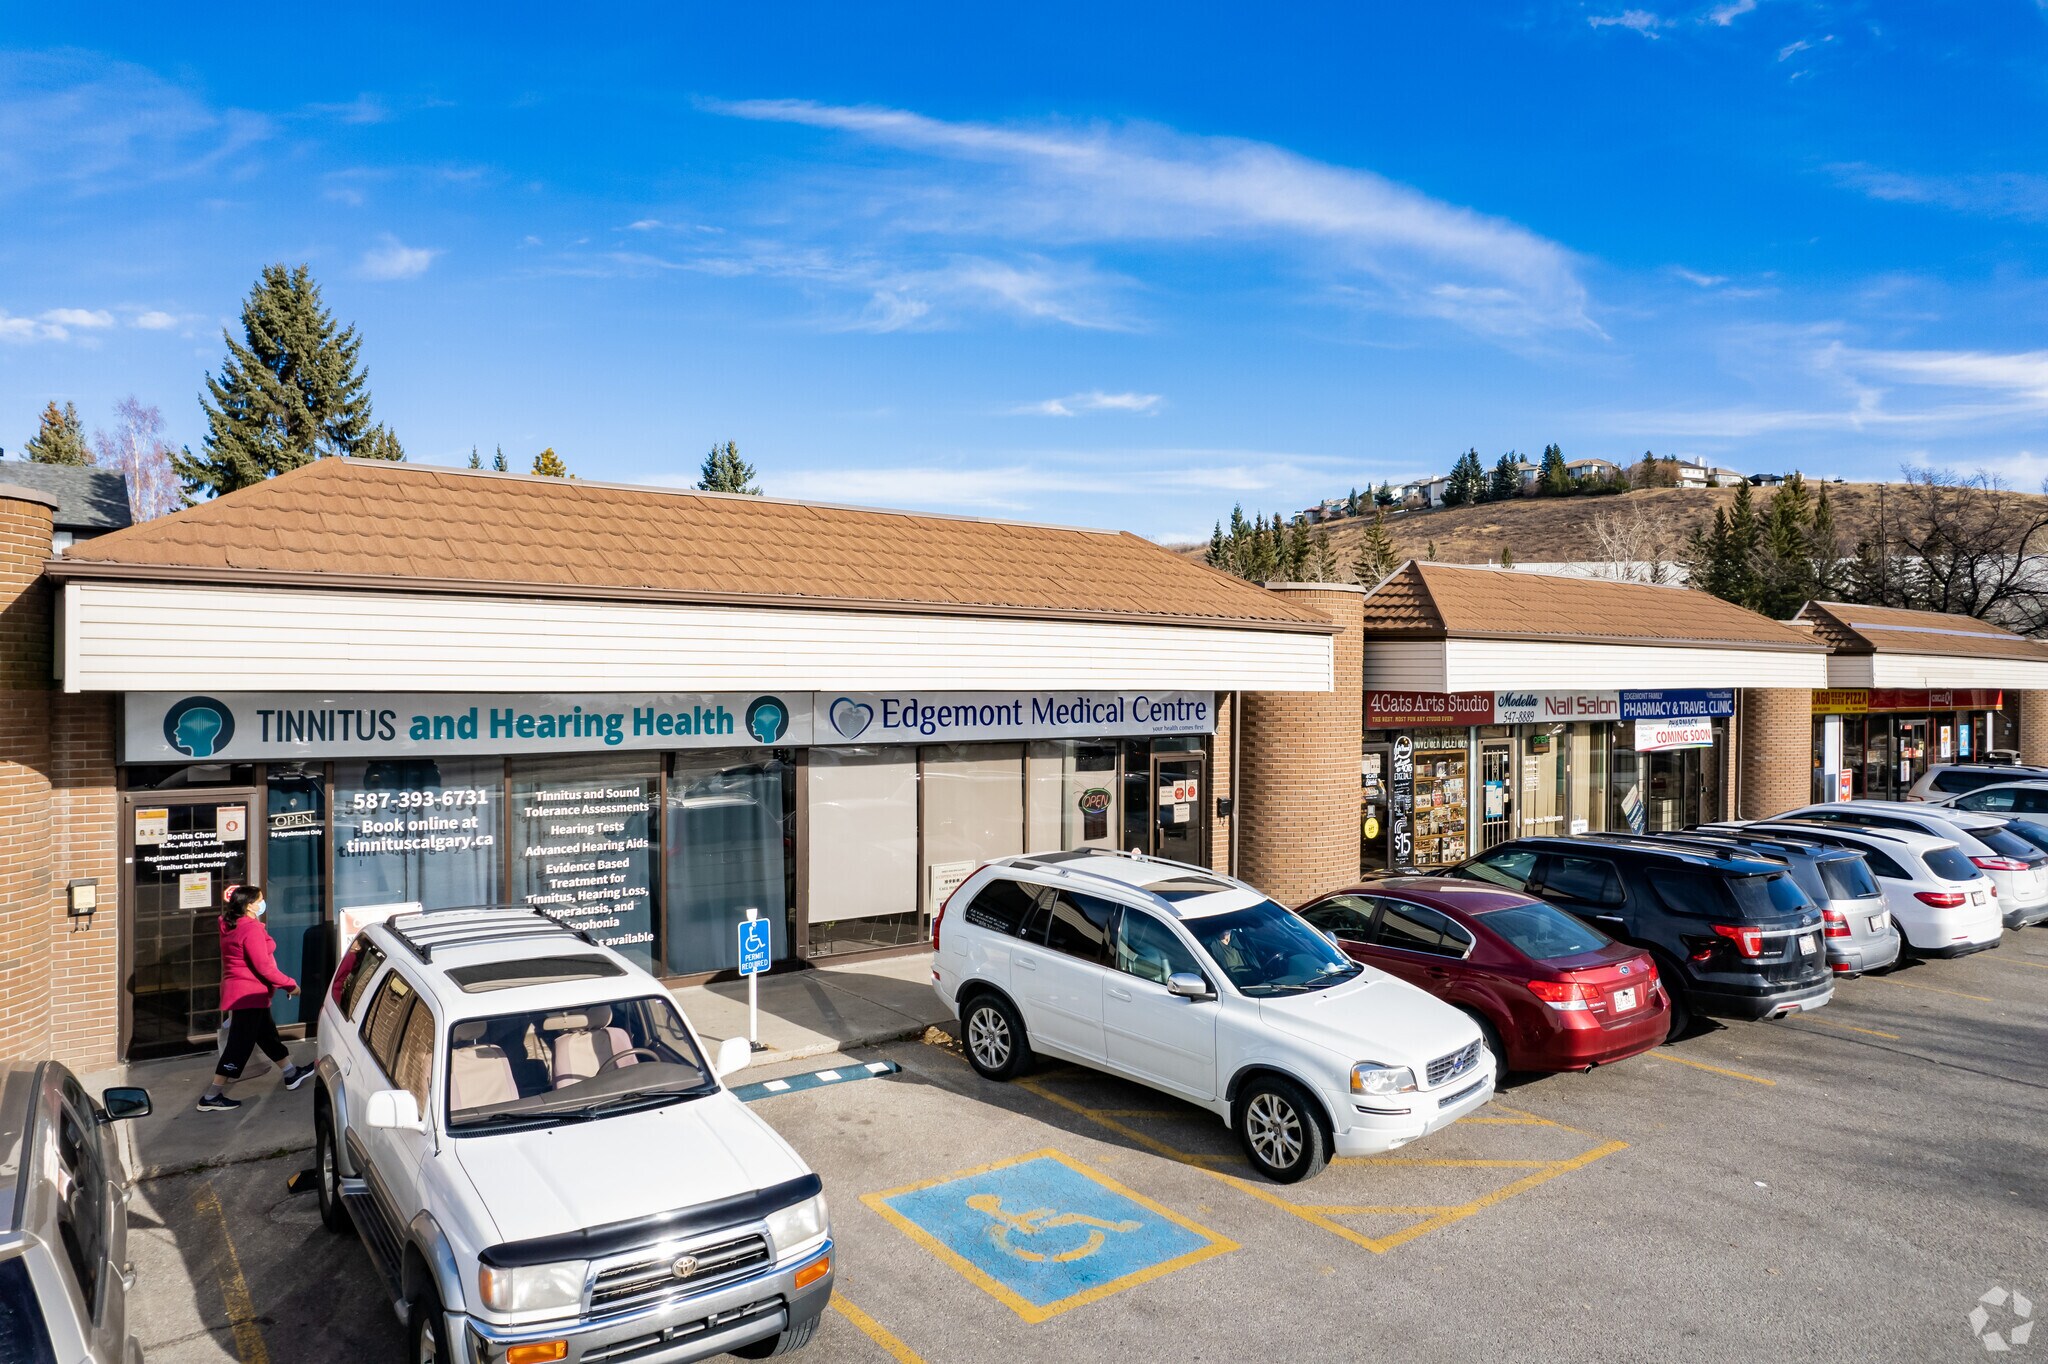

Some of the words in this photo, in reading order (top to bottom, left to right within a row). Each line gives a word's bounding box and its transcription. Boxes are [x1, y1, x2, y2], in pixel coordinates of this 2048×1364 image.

[1371, 694, 1412, 712] 4Cats
[1414, 695, 1445, 712] Arts
[1448, 694, 1489, 712] Studio
[1498, 692, 1538, 707] Modella
[1545, 696, 1573, 715] Nail
[1577, 696, 1617, 714] Salon
[1845, 692, 1867, 705] PIZZA
[881, 698, 1024, 735] Edgemont
[1032, 696, 1125, 726] Medical
[1132, 695, 1207, 723] Centre
[1624, 702, 1671, 716] PHARMACY
[1672, 701, 1679, 714] &
[1680, 701, 1708, 714] TRAVEL
[1709, 700, 1732, 713] CLINIC
[1503, 711, 1534, 723] 547-8889
[1668, 719, 1698, 727] PHARMACY
[256, 709, 397, 743] TINNITUS
[409, 707, 478, 740] and
[490, 706, 624, 745] Hearing
[633, 705, 734, 736] Health
[1533, 736, 1549, 744] OPEN
[1656, 730, 1688, 743] COMING
[1690, 729, 1711, 741] SOON
[353, 790, 488, 809] 587-393-6731
[535, 790, 582, 801] Tinnitus
[583, 789, 604, 799] and
[606, 787, 640, 798] Sound
[1083, 794, 1108, 808] OPEN
[524, 807, 580, 817] Tolerance
[581, 803, 649, 814] Assessments
[275, 813, 312, 827] OPEN
[362, 820, 404, 834] Book
[408, 817, 458, 831] online
[462, 816, 479, 829] at
[551, 824, 594, 835] Hearing
[596, 822, 625, 832] Tests
[346, 834, 494, 853] tinnituscalgary.ca
[525, 843, 580, 857] Advanced
[582, 840, 625, 852] Hearing
[626, 838, 649, 849] Aids
[1394, 833, 1411, 853] $15
[144, 854, 180, 863] Registered
[180, 852, 203, 860] Clinical
[546, 863, 596, 875] Evidence
[597, 858, 630, 869] Based
[550, 875, 608, 889] Treatment
[610, 873, 627, 884] for
[526, 892, 576, 904] Tinnitus,
[577, 888, 621, 900] Hearing
[622, 887, 649, 897] Loss,
[543, 903, 612, 919] yperacusis,
[614, 901, 635, 911] and
[606, 932, 654, 946] available
[745, 951, 764, 962] PERMIT
[742, 959, 768, 970] REQUIRED
